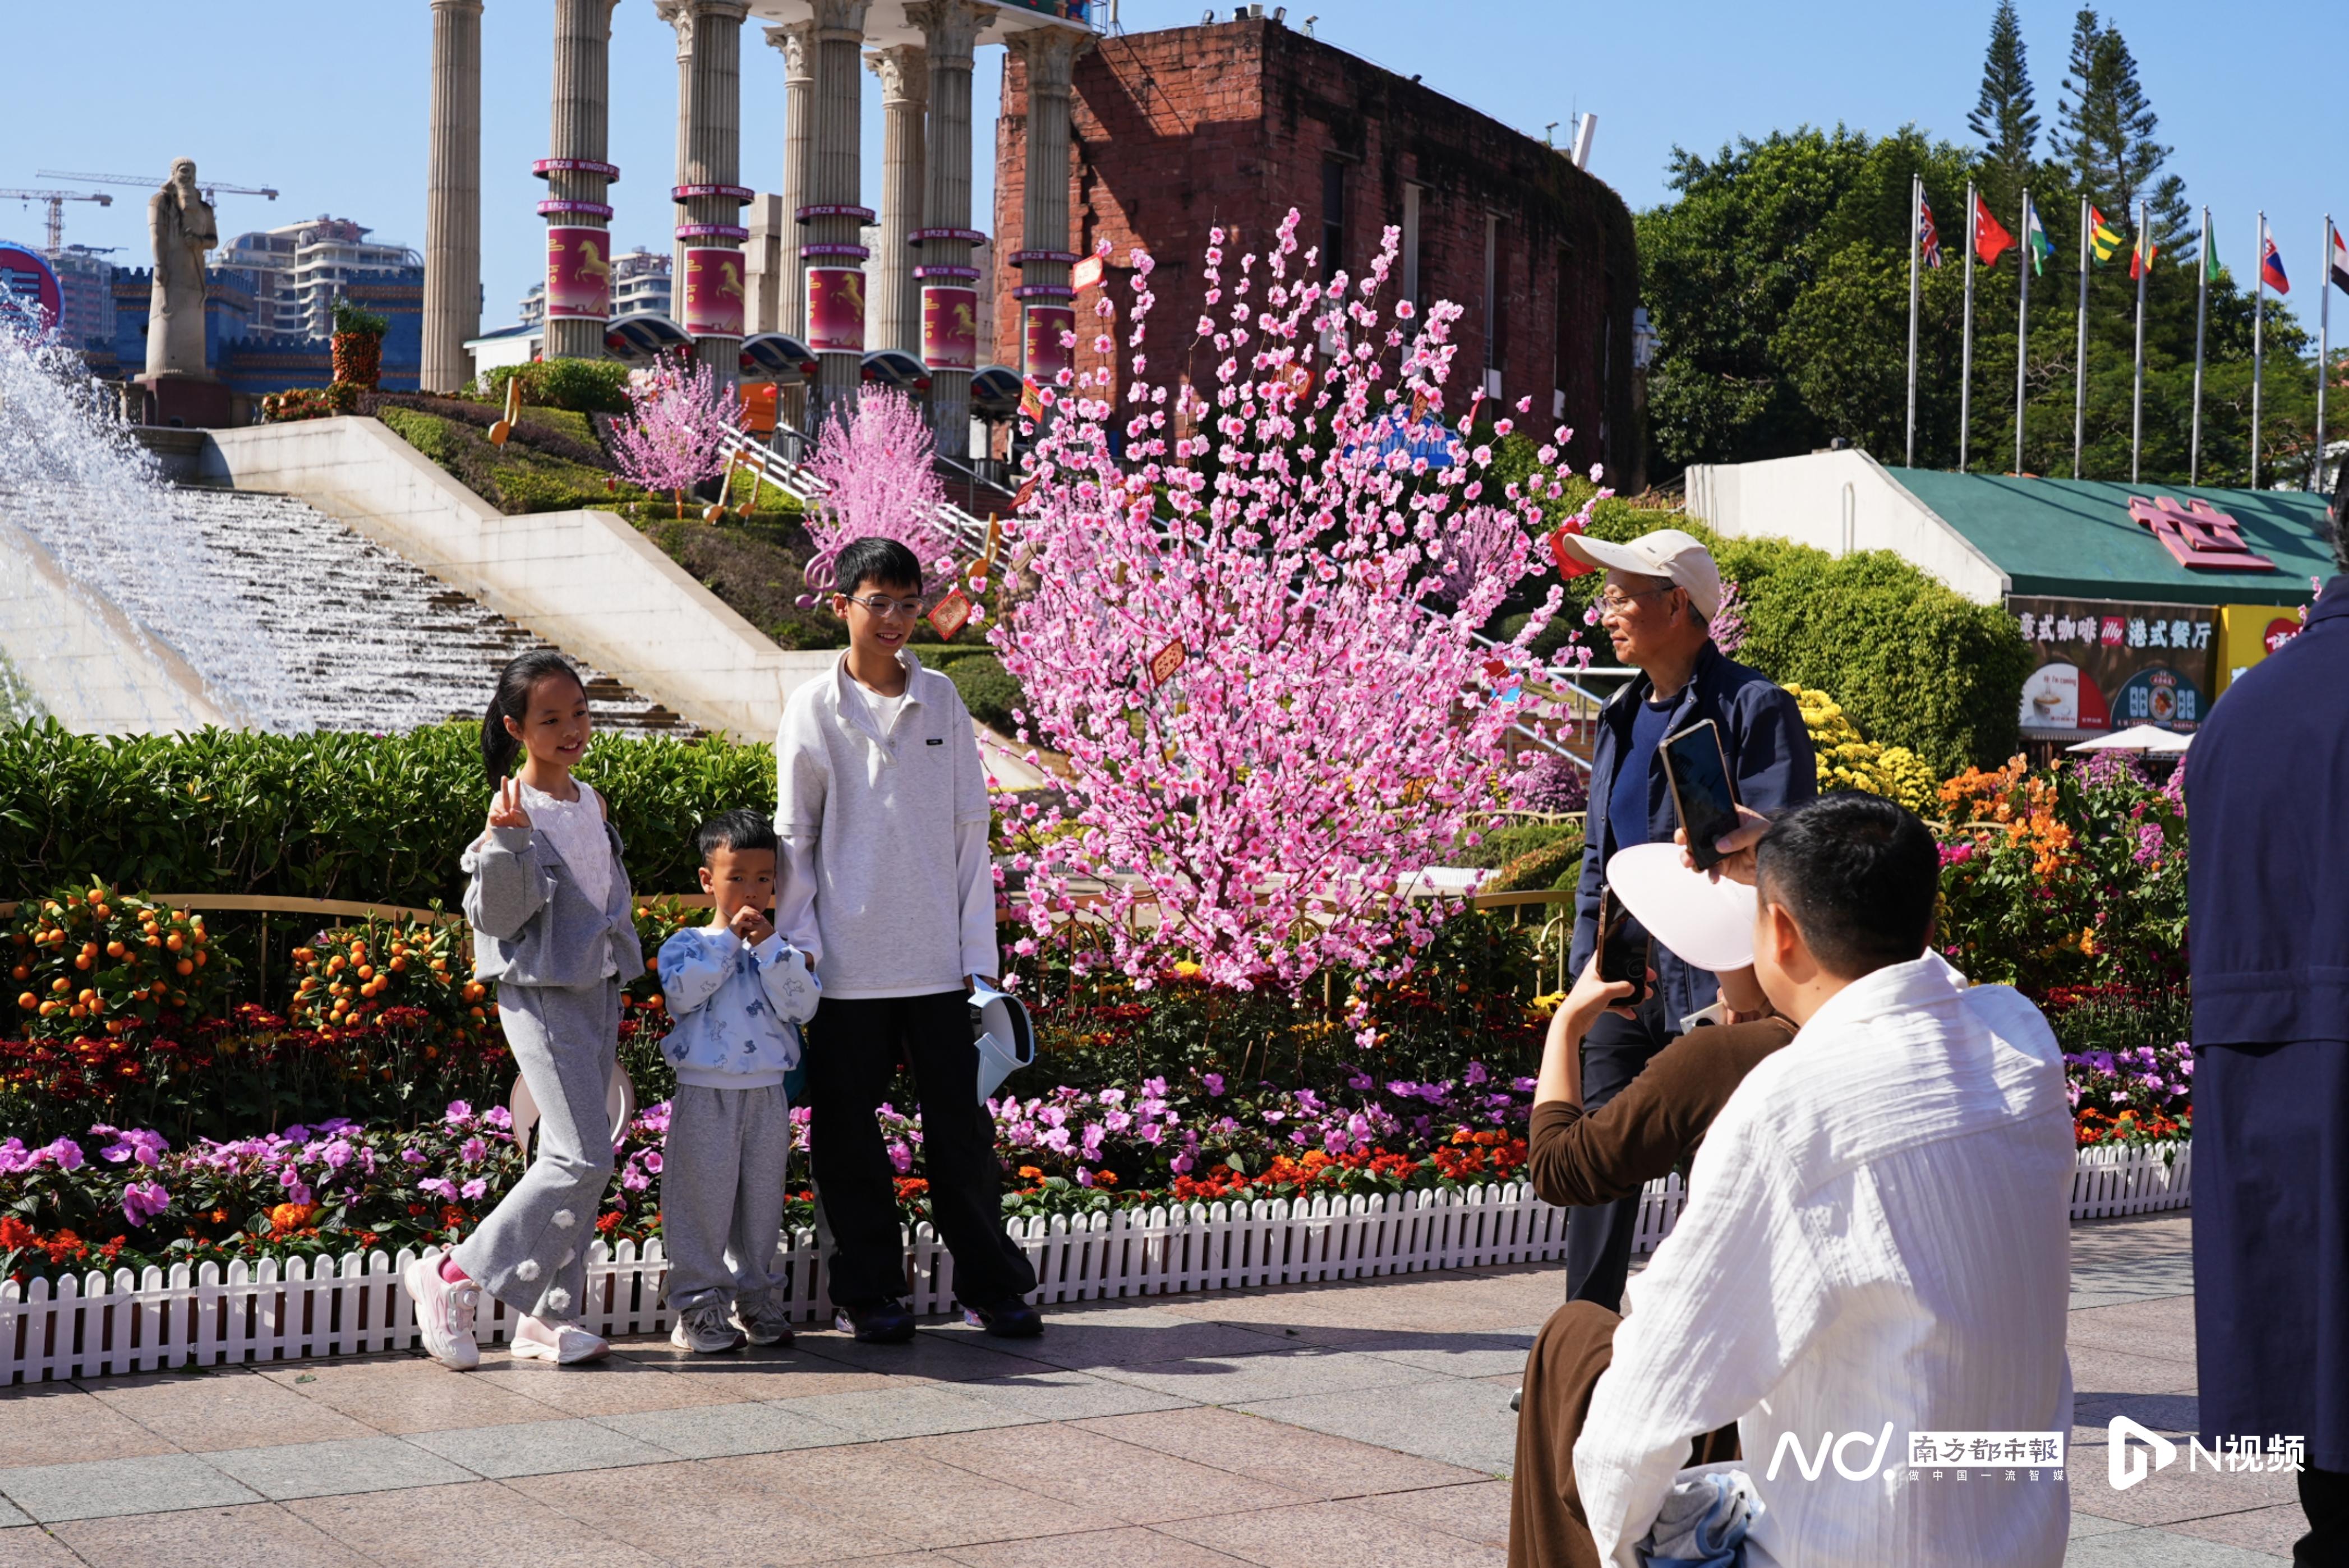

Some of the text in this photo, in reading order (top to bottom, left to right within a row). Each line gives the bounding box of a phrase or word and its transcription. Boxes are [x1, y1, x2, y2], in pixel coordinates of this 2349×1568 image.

[578, 161, 609, 171] WINDOW
[577, 204, 604, 213] WINDOW
[2020, 612, 2212, 649] 意式咖啡 illy 港式餐厅
